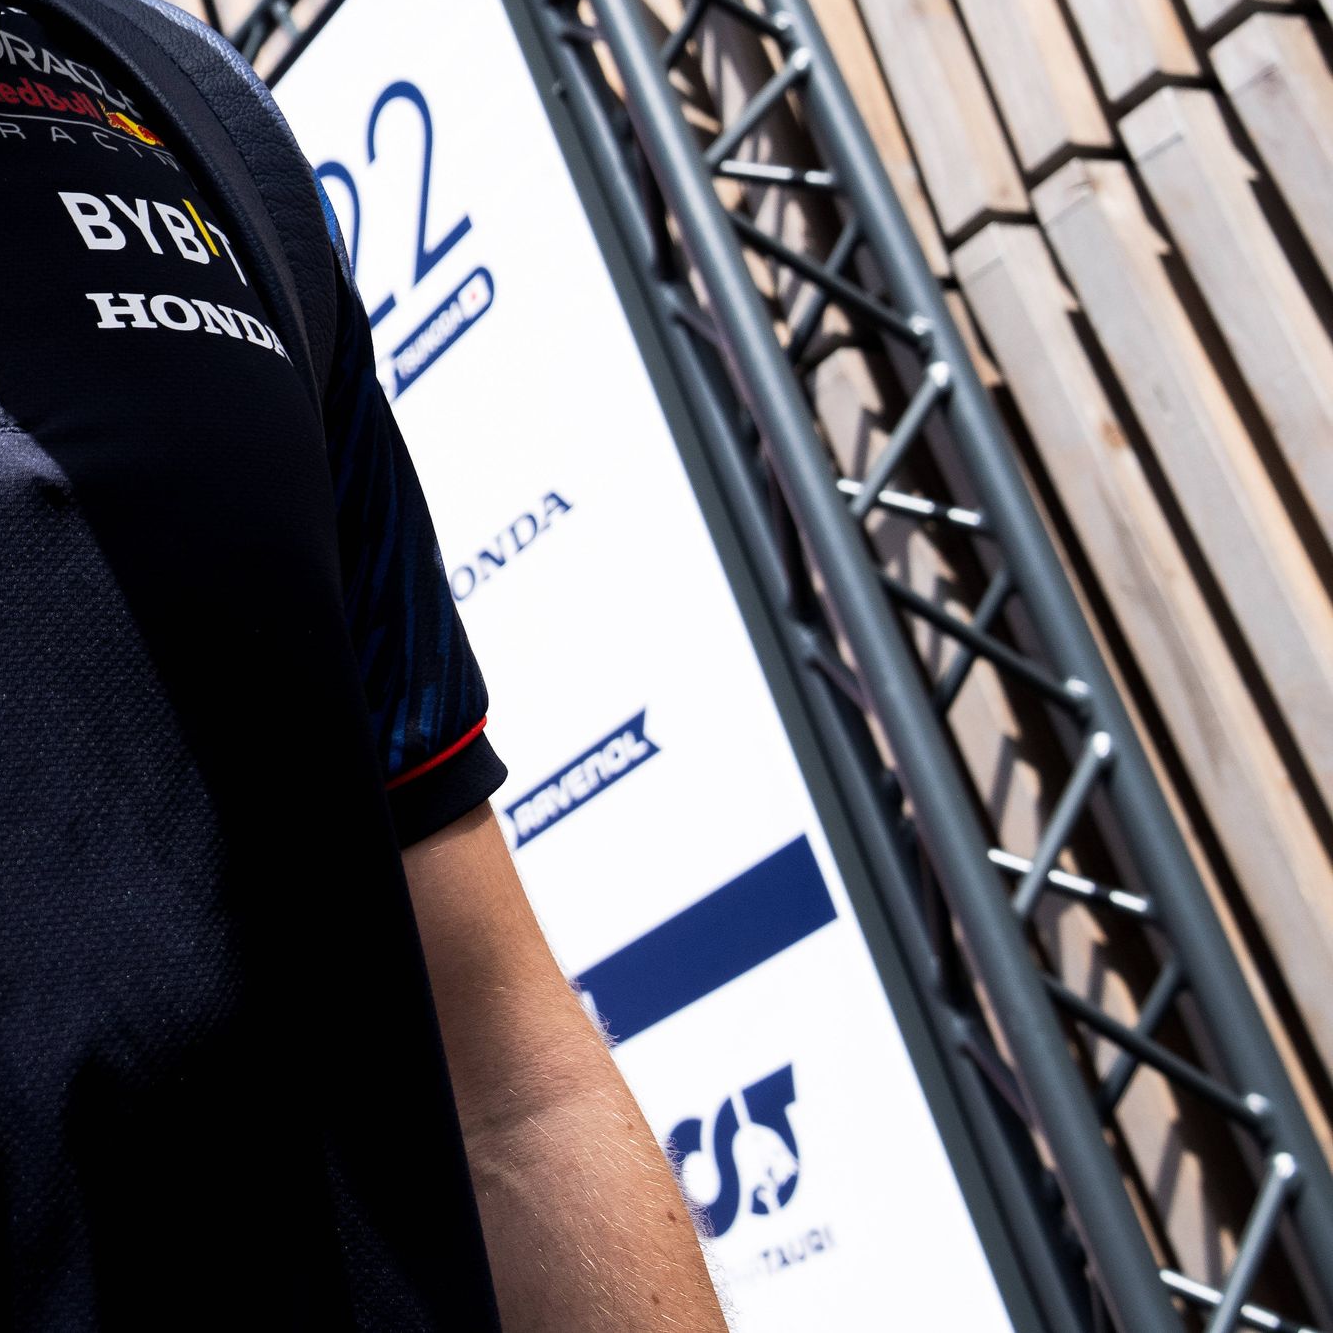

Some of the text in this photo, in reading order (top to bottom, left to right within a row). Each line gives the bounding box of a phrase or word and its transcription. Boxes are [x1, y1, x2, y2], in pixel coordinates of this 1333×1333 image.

[57, 191, 248, 286] BYBIT
[85, 293, 294, 366] HONDA
[450, 491, 574, 602] ONDA
